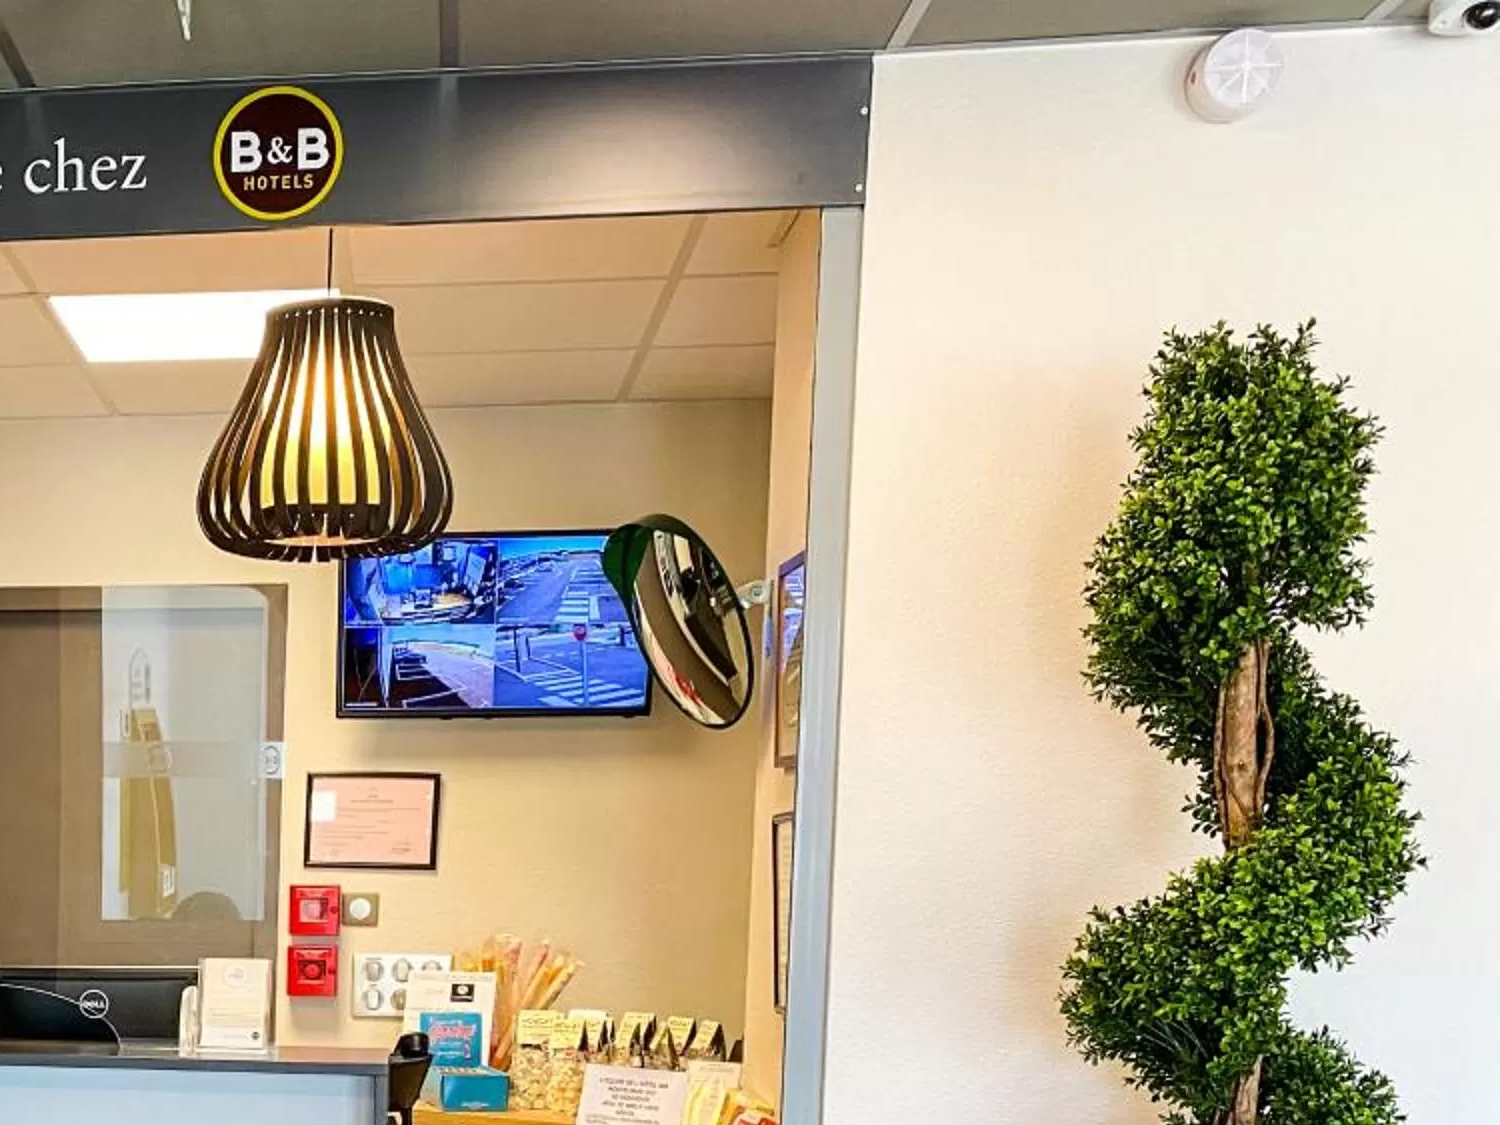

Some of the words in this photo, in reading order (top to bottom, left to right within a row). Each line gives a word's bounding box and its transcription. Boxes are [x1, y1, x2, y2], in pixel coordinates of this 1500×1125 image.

[24, 138, 147, 193] chez
[231, 128, 330, 173] B&B
[243, 174, 314, 191] HOTELS
